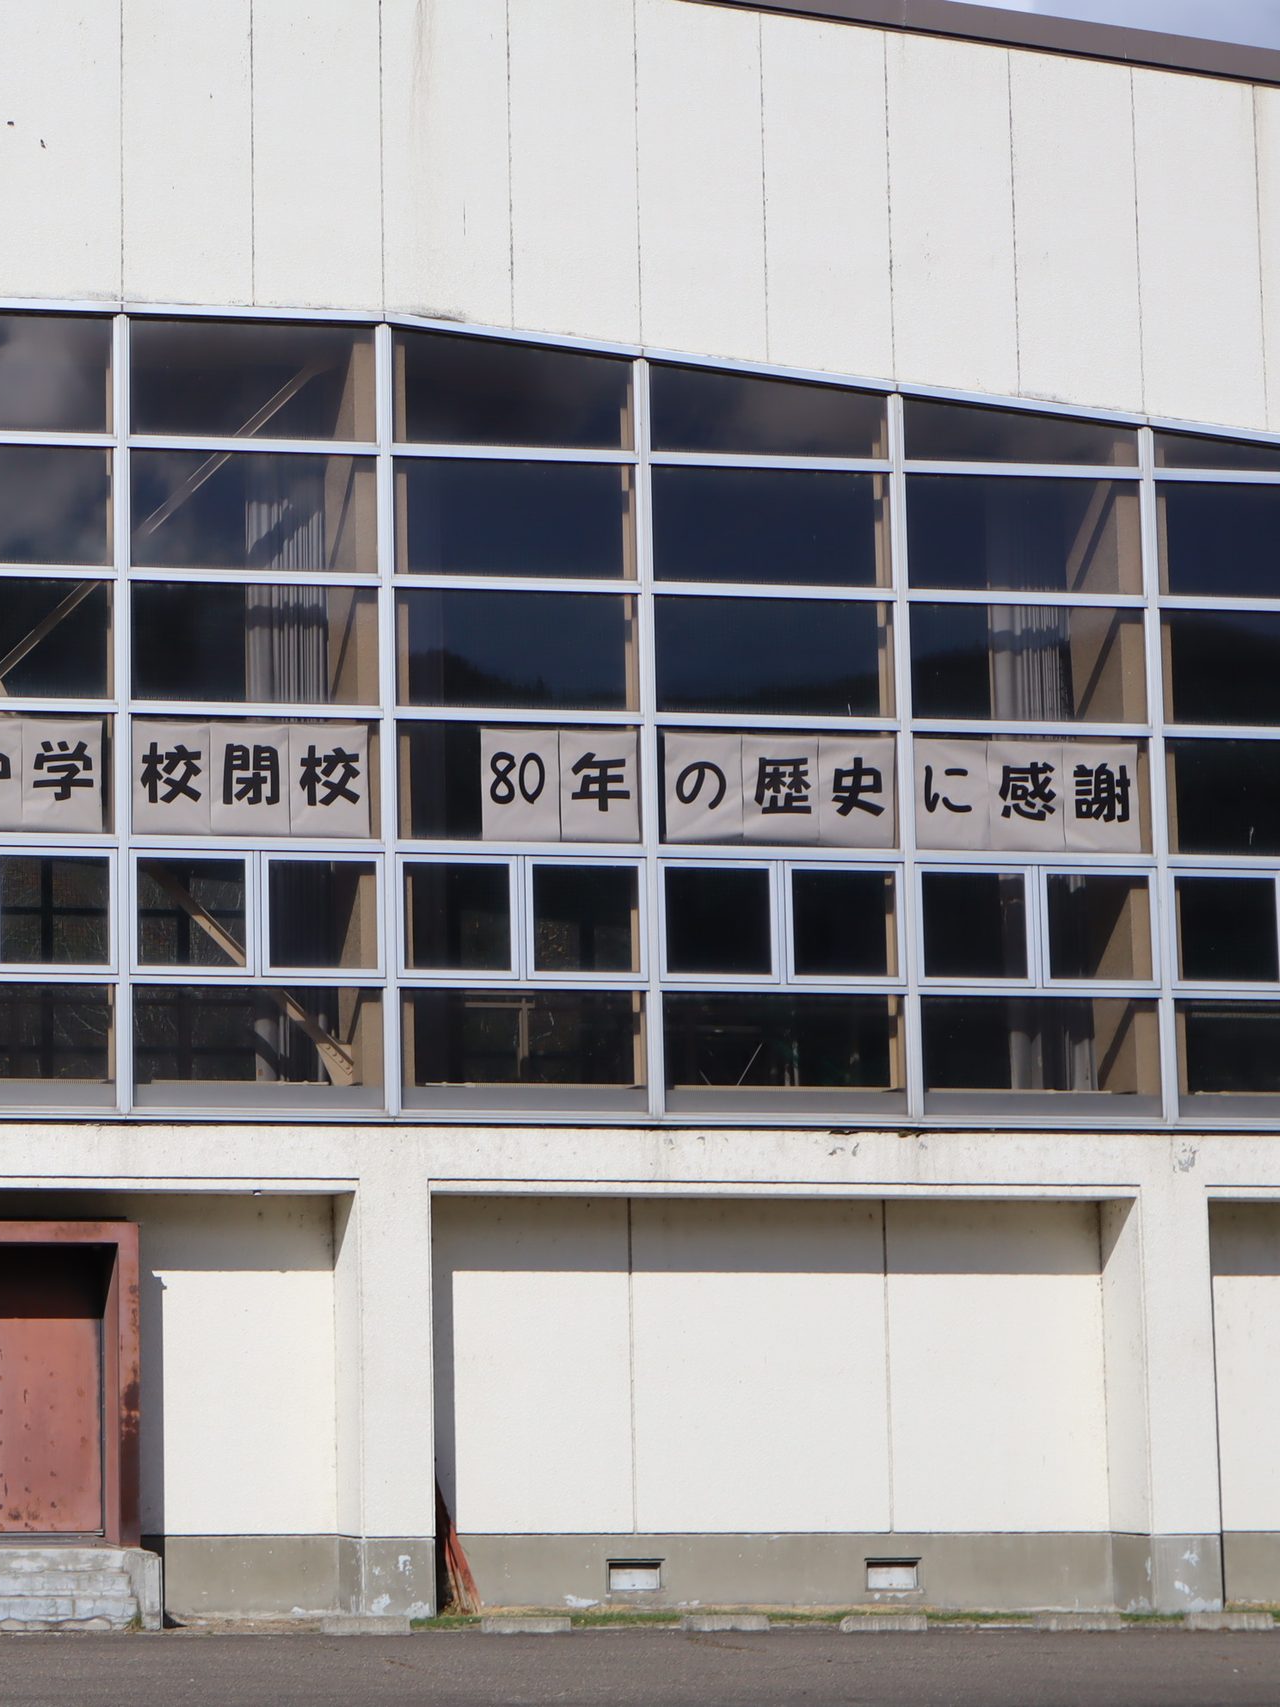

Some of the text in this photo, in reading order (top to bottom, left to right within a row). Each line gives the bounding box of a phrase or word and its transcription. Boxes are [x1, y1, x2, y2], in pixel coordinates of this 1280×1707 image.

[489, 751, 1131, 823] 80年の歴史に感謝
